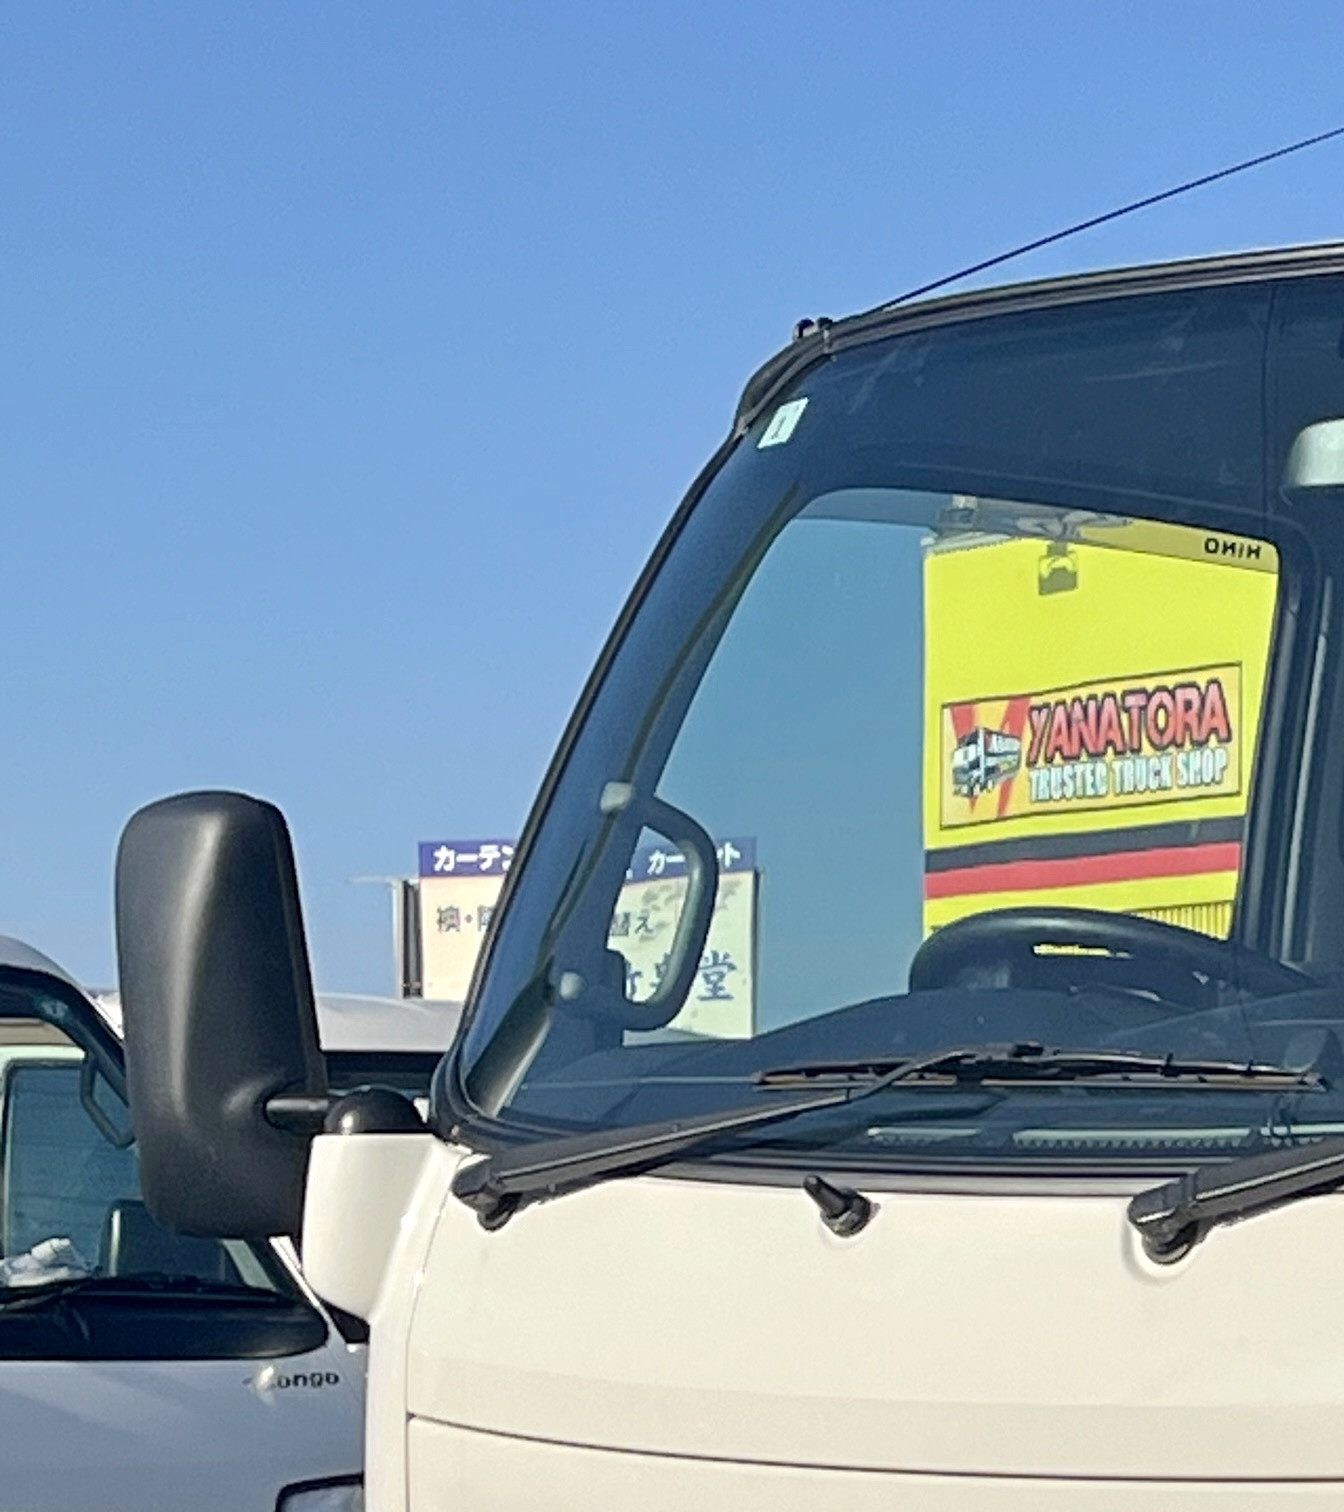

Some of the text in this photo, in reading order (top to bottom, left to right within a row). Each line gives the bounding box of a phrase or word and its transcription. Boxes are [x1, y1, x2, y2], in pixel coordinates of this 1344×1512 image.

[1026, 678, 1232, 764] YANATORA
[1029, 745, 1228, 802] TRUSTED TRUCK SHOP
[261, 1369, 340, 1389] ongo
